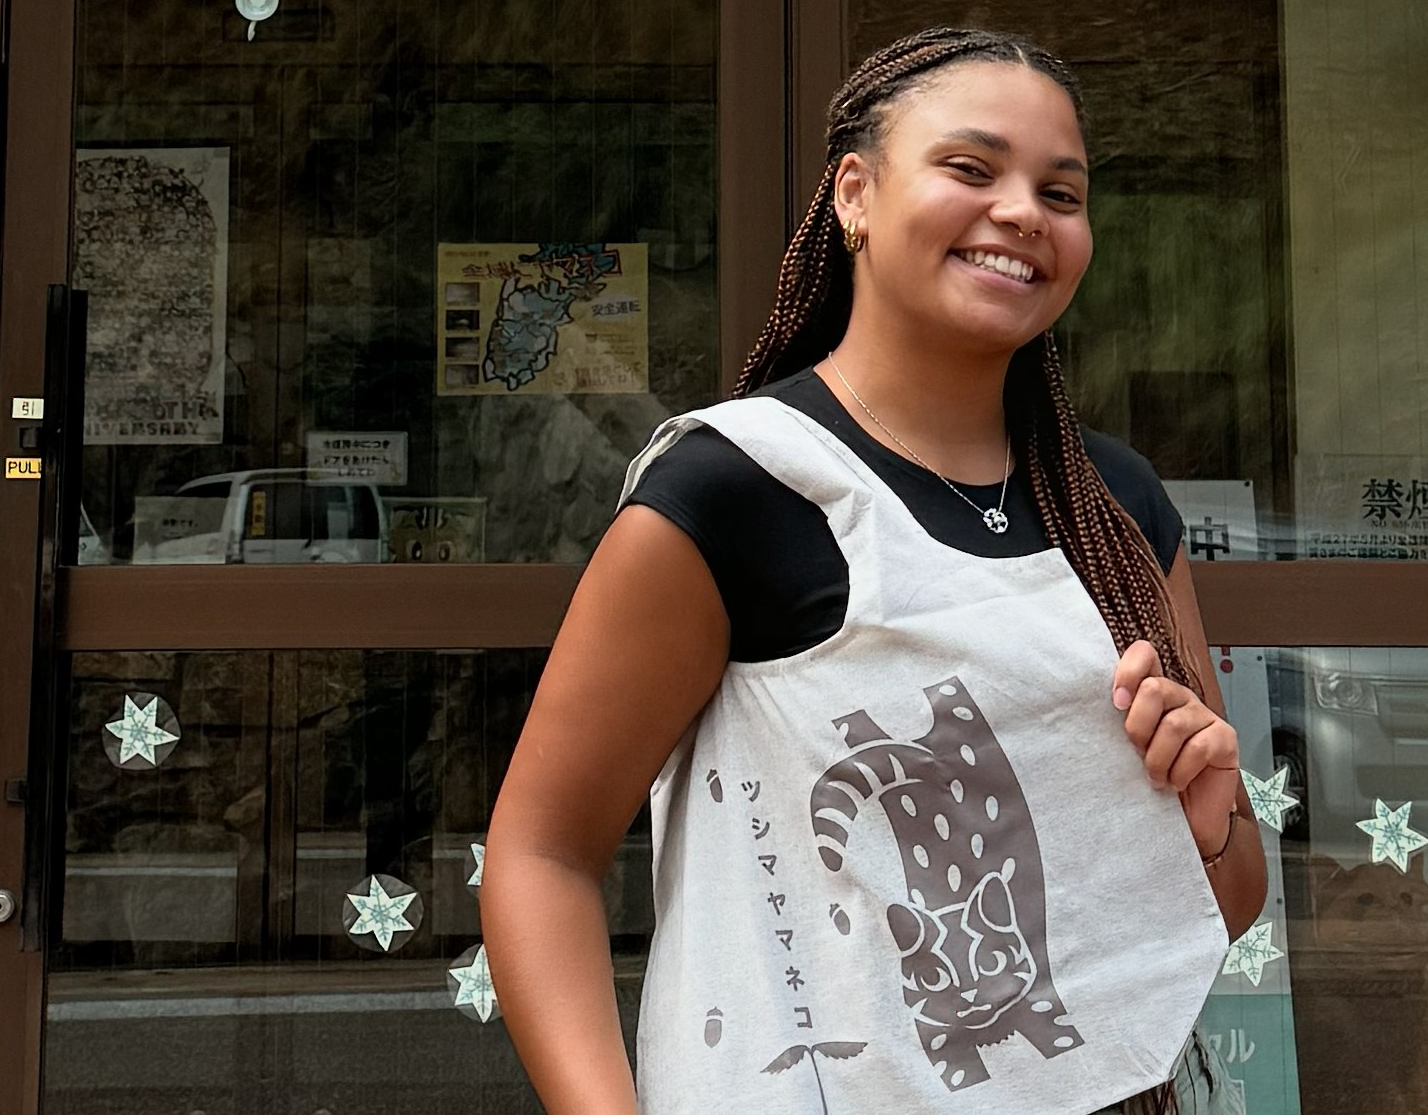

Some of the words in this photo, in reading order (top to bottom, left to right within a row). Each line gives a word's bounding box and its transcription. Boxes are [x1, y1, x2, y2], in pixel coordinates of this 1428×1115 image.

[740, 779, 814, 1029] ツシマヤマネコ
